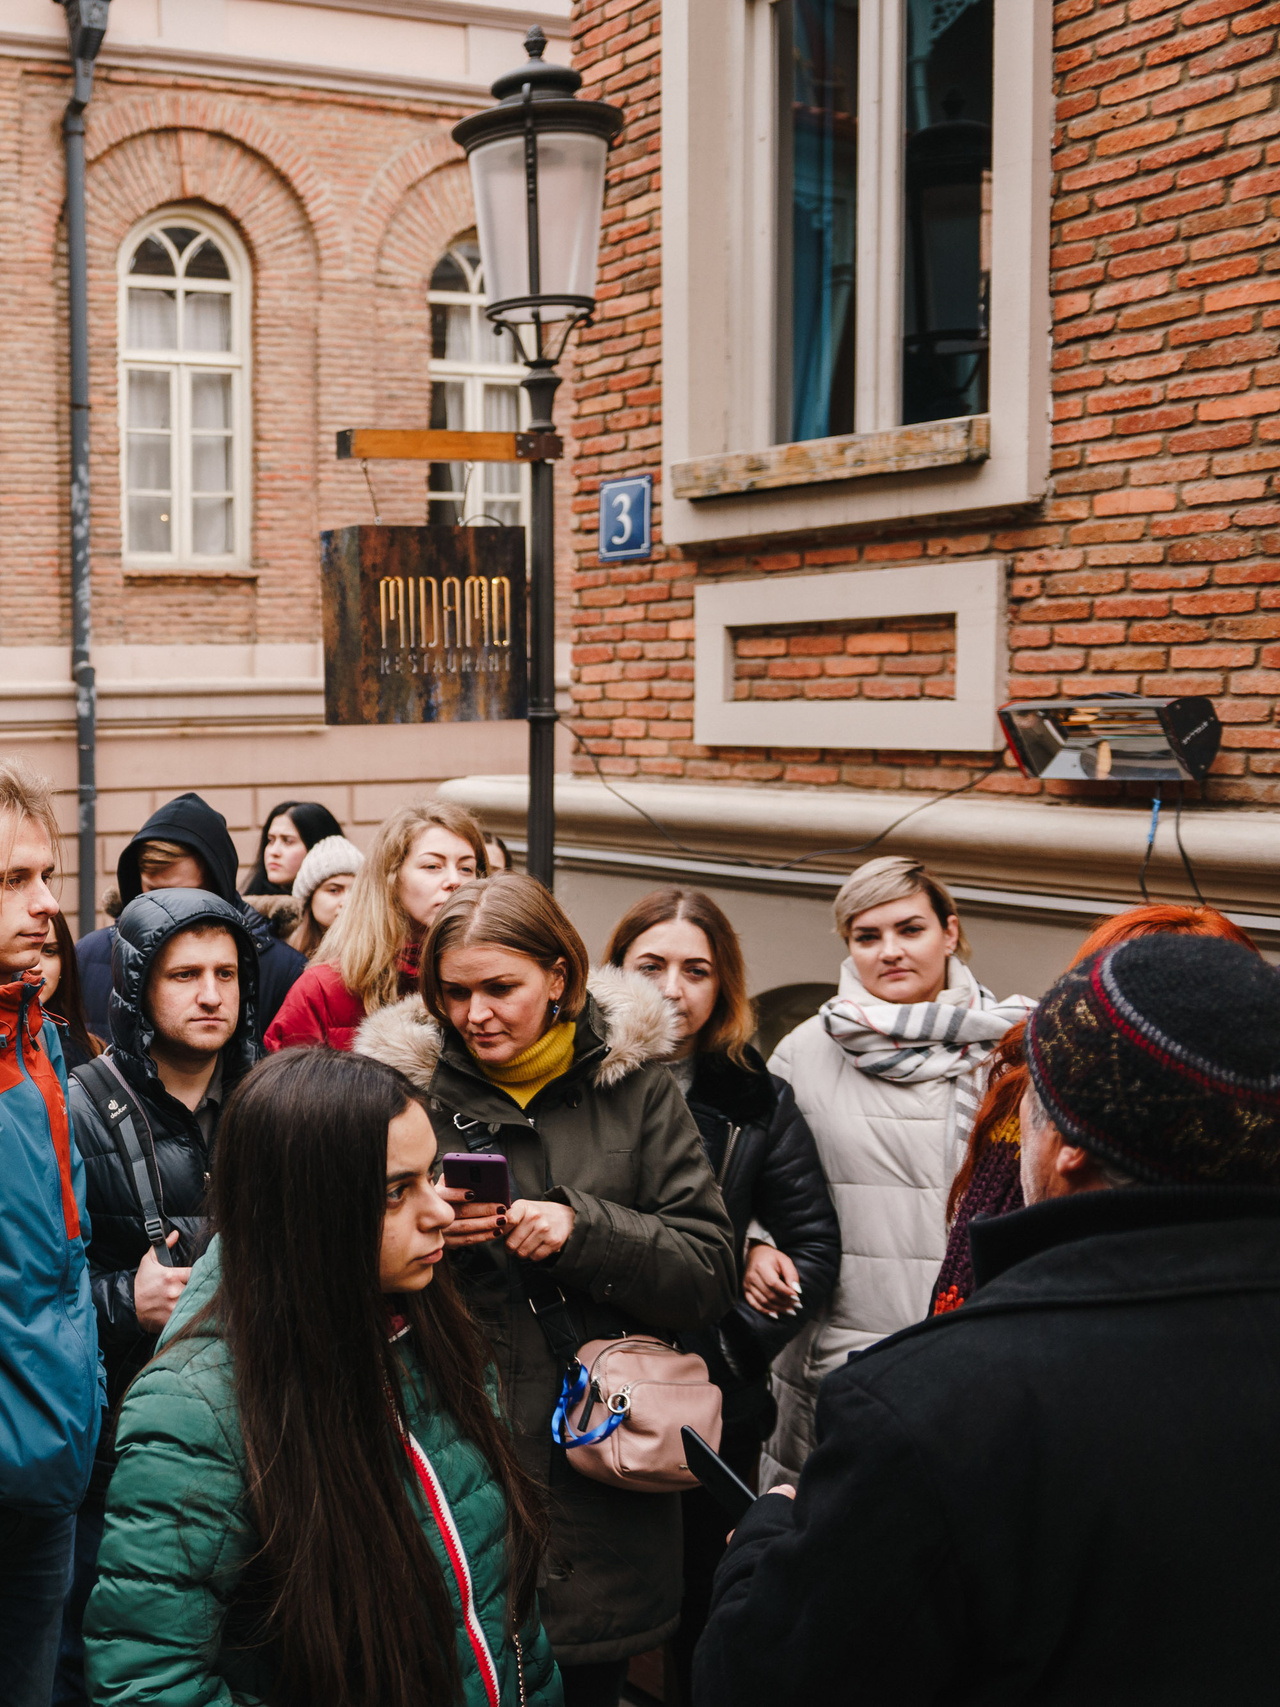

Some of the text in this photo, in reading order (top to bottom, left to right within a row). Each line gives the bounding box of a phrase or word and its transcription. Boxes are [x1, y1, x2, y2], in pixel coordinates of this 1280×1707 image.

[611, 492, 633, 546] 3
[379, 576, 511, 649] MIDAMO
[380, 652, 512, 675] RESTAURANT
